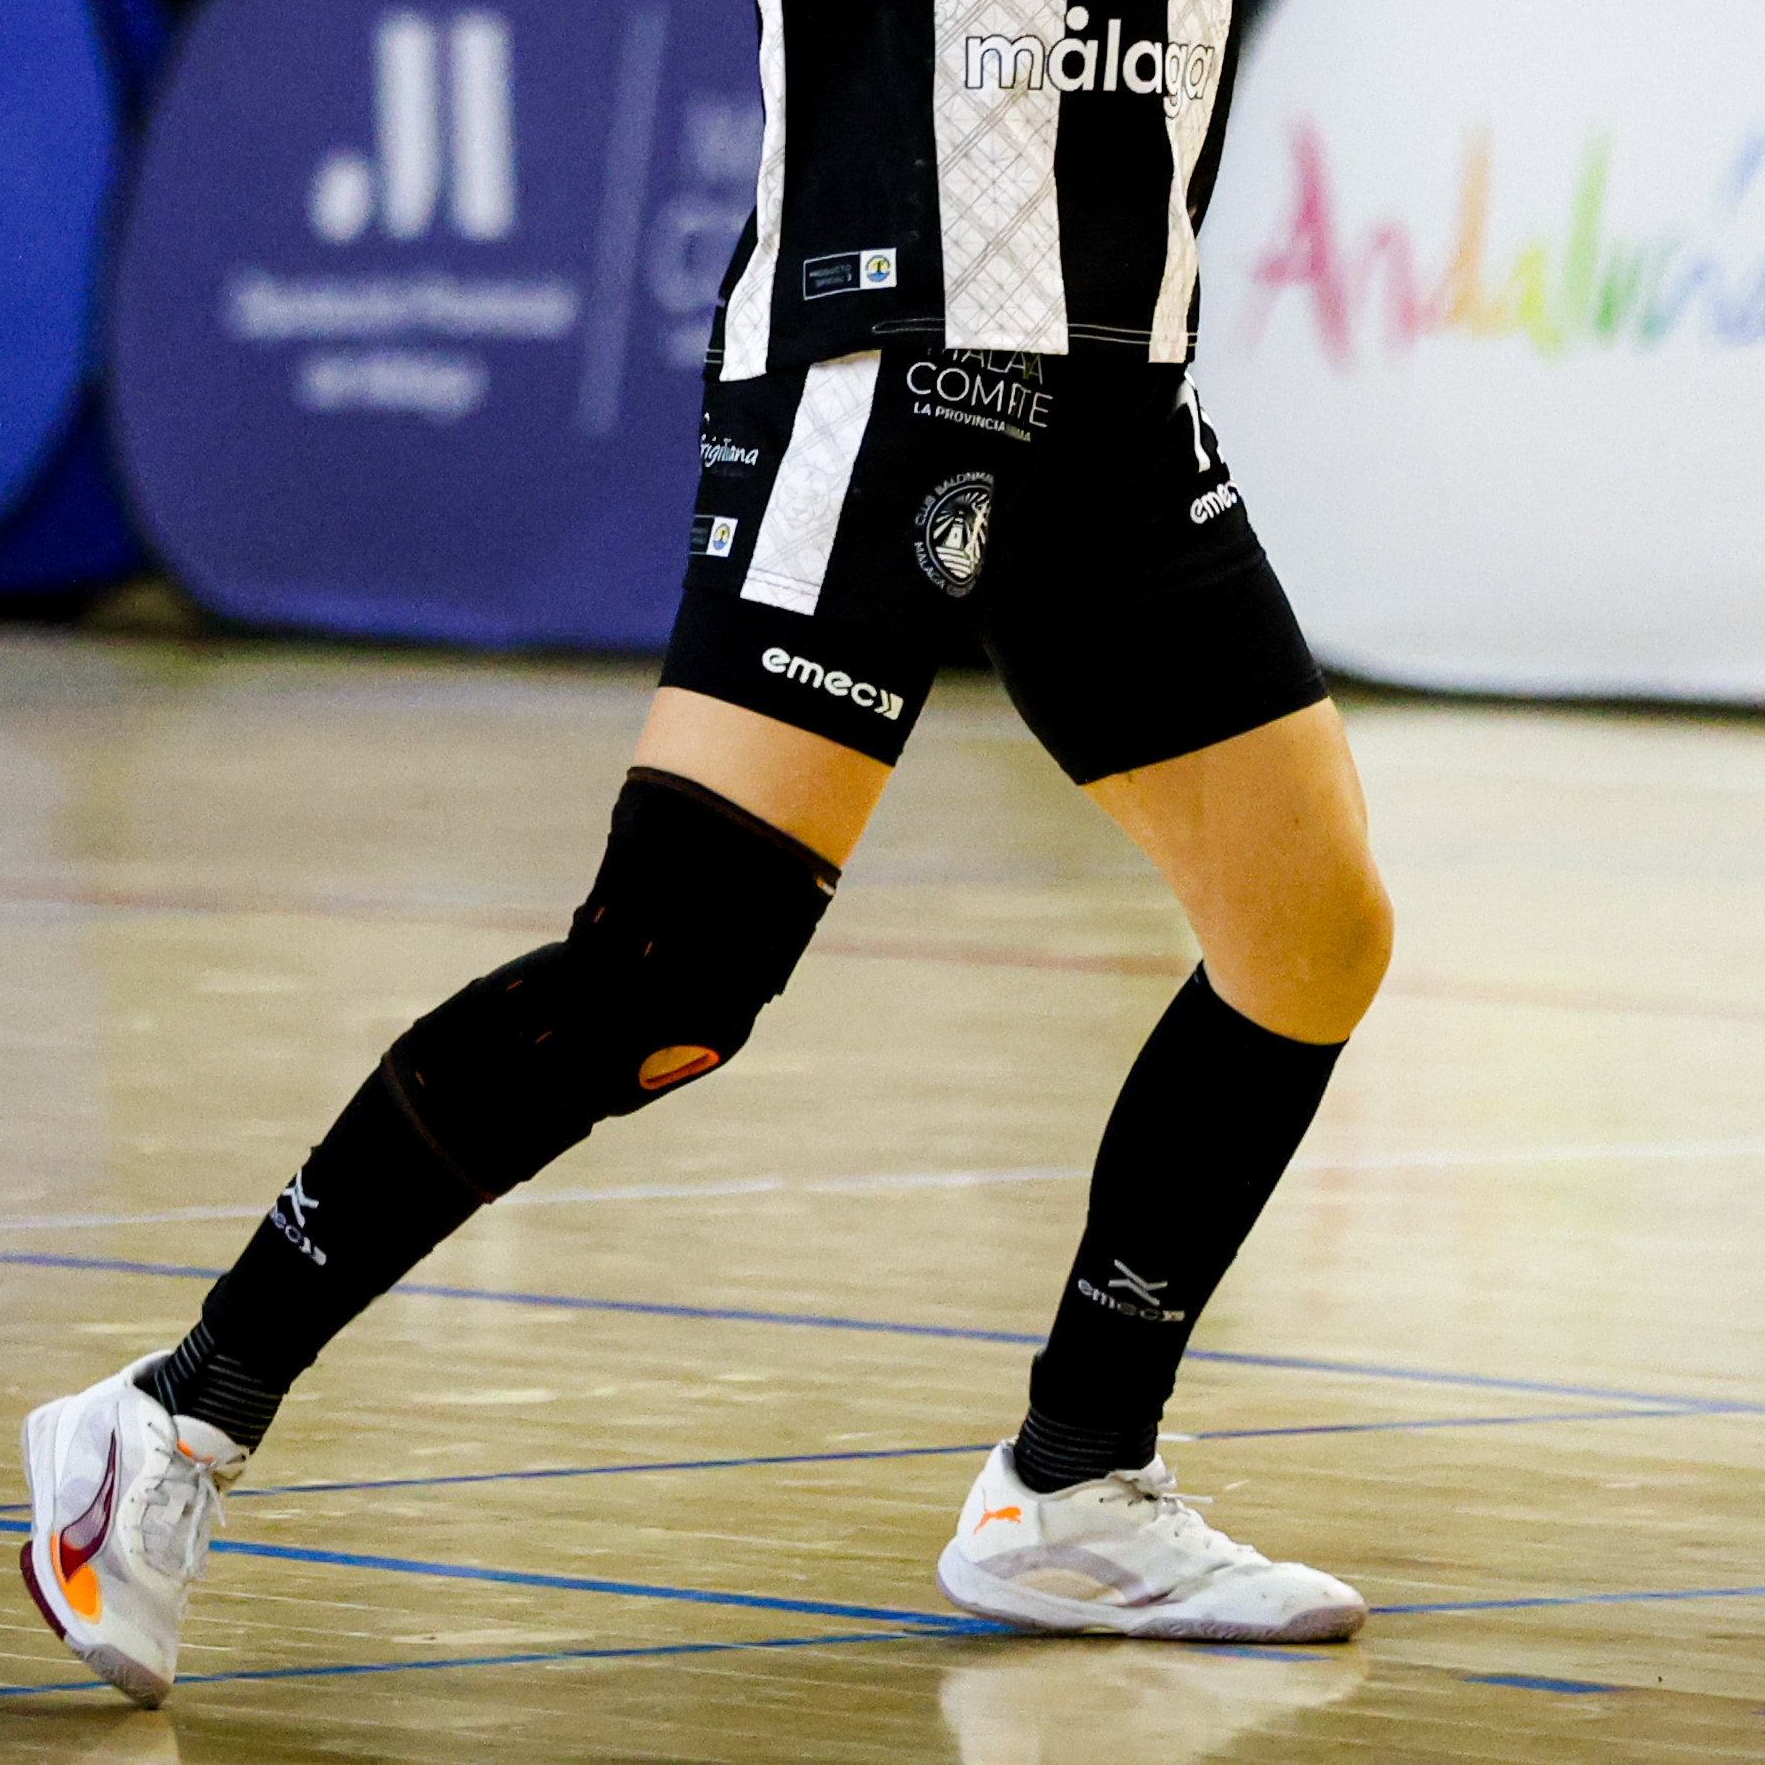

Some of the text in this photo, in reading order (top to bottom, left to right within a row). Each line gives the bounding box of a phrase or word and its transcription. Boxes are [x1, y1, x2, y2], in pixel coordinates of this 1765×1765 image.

[964, 4, 1216, 122] málaga
[906, 361, 1054, 428] COMTE
[913, 401, 1006, 432] LA PROVINCIA
